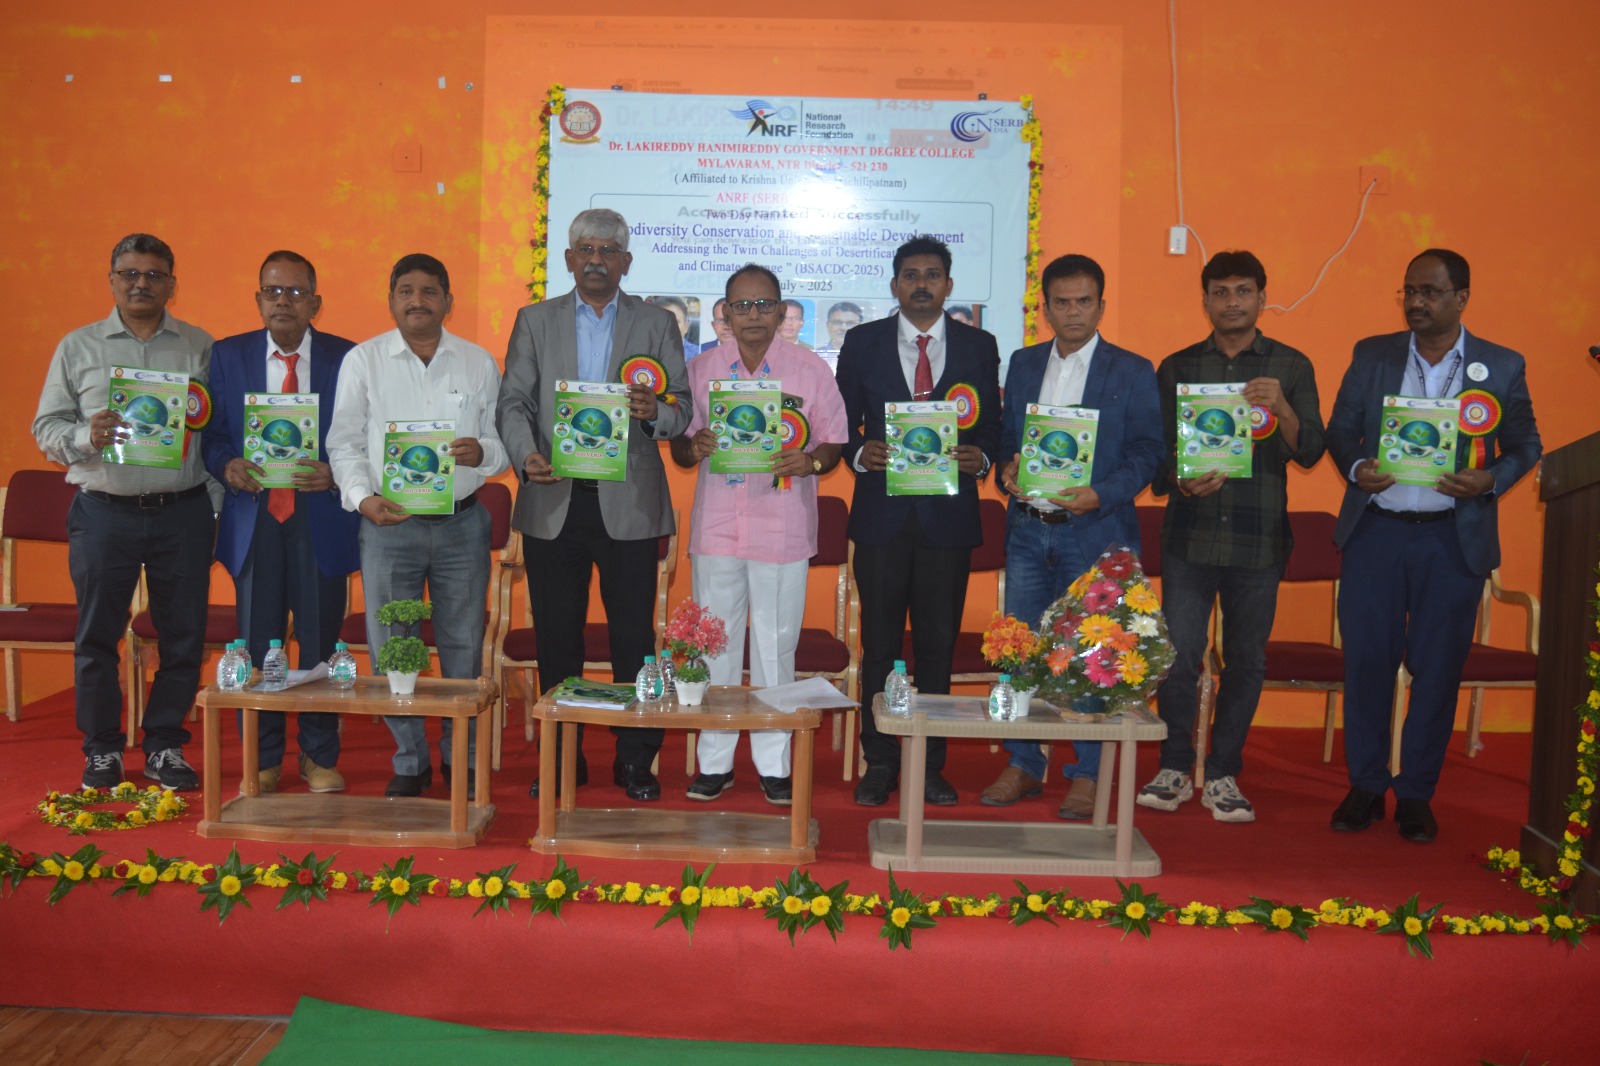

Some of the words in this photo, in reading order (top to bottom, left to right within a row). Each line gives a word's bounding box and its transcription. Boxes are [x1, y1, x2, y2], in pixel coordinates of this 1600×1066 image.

[805, 112, 842, 122] National
[993, 118, 1024, 128] SERB
[805, 121, 846, 131] Research
[805, 130, 854, 140] Foundation
[608, 141, 624, 151] Dr.
[627, 141, 695, 153] LAKIREDDY
[697, 142, 781, 155] HANIMIREDDY
[783, 143, 866, 157] GOVERNMENT
[869, 146, 917, 158] DEGREE
[919, 147, 976, 159] COLLEGE
[697, 158, 775, 171] MYLAVARAM,
[776, 159, 800, 171] NTR
[850, 161, 867, 172] 521
[870, 161, 888, 173] 230
[682, 174, 726, 184] Affiliated
[729, 175, 738, 184] to
[741, 174, 777, 185] Krishna
[716, 192, 749, 204] ANRF
[704, 208, 727, 220] Two
[730, 209, 753, 223] Day
[692, 223, 775, 239] Conservation
[651, 242, 710, 256] Addressing
[713, 243, 728, 254] the
[731, 244, 758, 255] Twin
[761, 244, 818, 259] Challenges
[821, 246, 833, 257] of
[678, 261, 697, 272] and
[700, 261, 741, 273] Climate
[795, 263, 884, 278] (BSACDC-2025)
[807, 280, 833, 292] 2025
